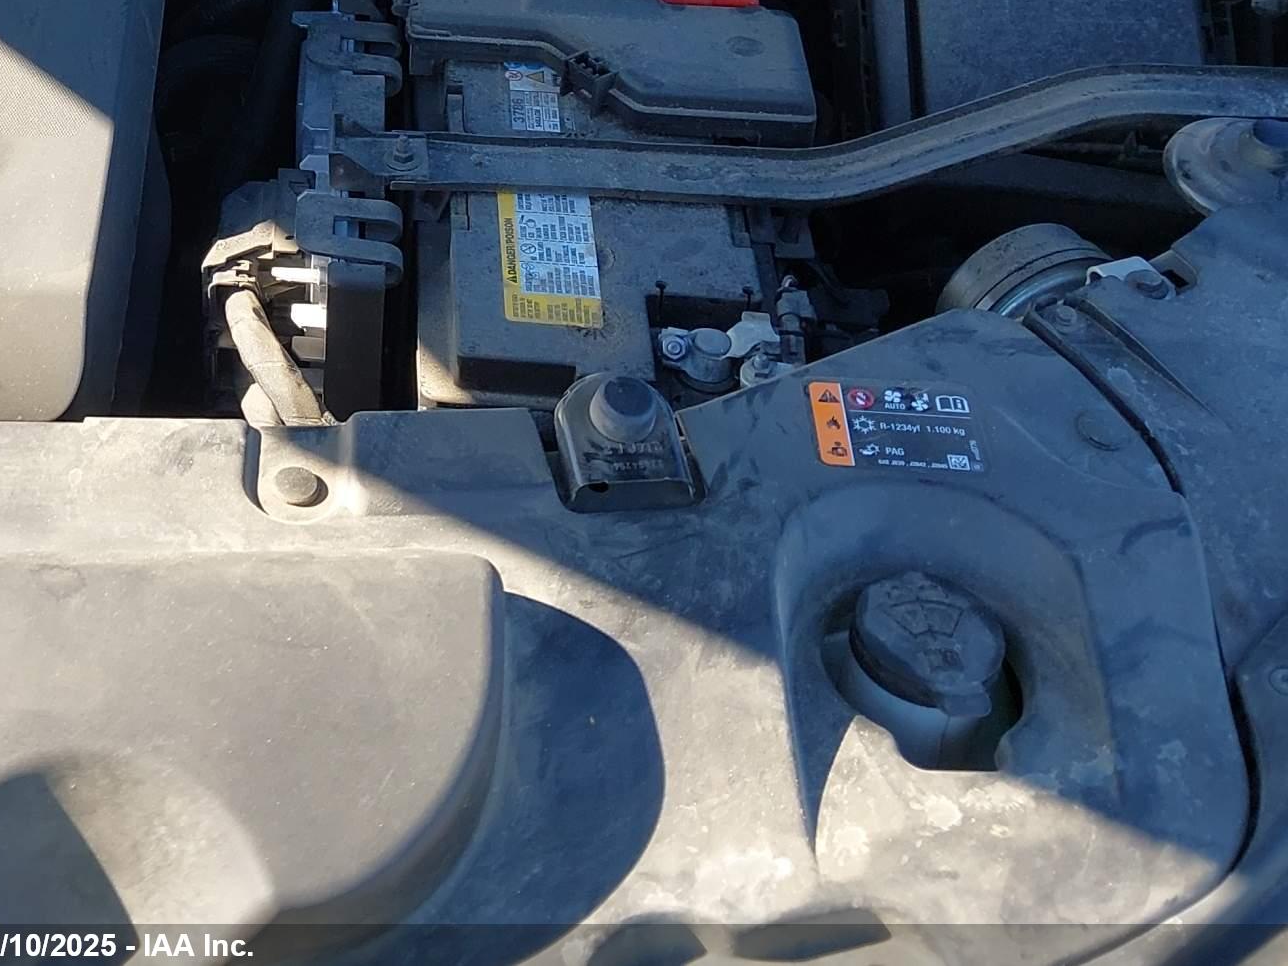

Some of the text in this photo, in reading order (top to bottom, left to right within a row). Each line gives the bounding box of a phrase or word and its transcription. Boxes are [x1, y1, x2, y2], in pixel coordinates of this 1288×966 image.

[884, 402, 906, 410] AUTO
[926, 425, 951, 434] 1.100
[885, 446, 905, 456] PAG
